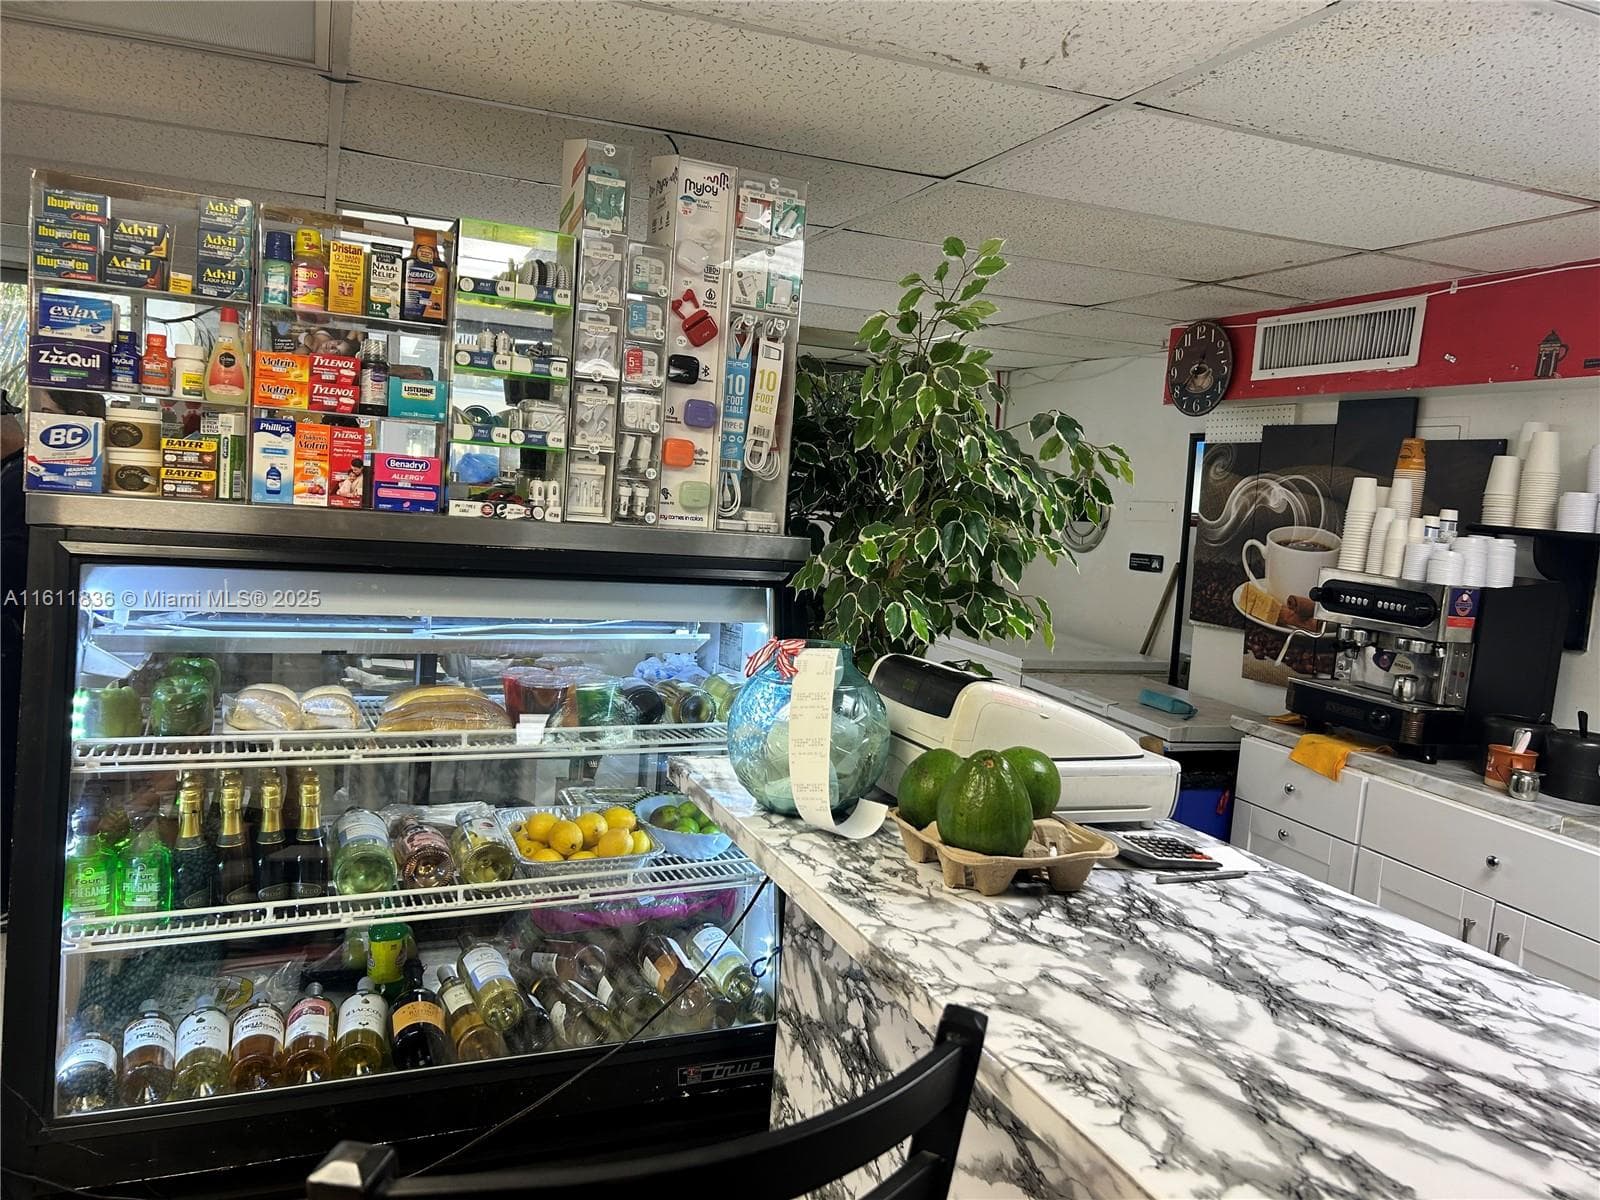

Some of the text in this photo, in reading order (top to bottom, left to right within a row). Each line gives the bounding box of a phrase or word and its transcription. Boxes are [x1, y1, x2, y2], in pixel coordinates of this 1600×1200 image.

[47, 195, 99, 212] Ibuprofen
[205, 200, 240, 215] Advil
[115, 221, 158, 238] Advil
[202, 233, 237, 247] Advil
[331, 243, 363, 255] Dristan
[36, 254, 89, 271] Ibupfen
[372, 262, 399, 272] NASAL
[202, 267, 237, 281] Advil
[372, 269, 396, 279] RELIEF
[1197, 325, 1206, 340] 12
[1184, 333, 1191, 347] 11
[1175, 347, 1184, 361] 10
[1216, 340, 1225, 355] 2
[38, 350, 100, 368] ZzzQuil
[261, 356, 295, 368] Motrin
[312, 355, 355, 368] TYLENOL
[1171, 366, 1177, 379] 9
[1220, 360, 1228, 375] 3
[727, 374, 746, 396] 10
[759, 368, 777, 392] 10
[260, 383, 295, 395] Motrin
[312, 383, 354, 397] TYLENOL
[404, 385, 434, 395] LISTERINE
[1173, 385, 1180, 398] 8
[726, 395, 745, 406] FOOT
[755, 392, 774, 404] FOOT
[1182, 396, 1189, 409] 7
[726, 405, 743, 414] CABLE
[754, 404, 773, 415] CABLE
[1192, 399, 1200, 412] 6
[48, 427, 83, 445] BC
[333, 431, 362, 440] TYLENOL
[165, 439, 204, 449] BAYER
[298, 440, 328, 450] Motrin
[389, 459, 426, 470] Benadryl
[165, 468, 202, 478] BAYER
[391, 473, 425, 481] ALLERGY
